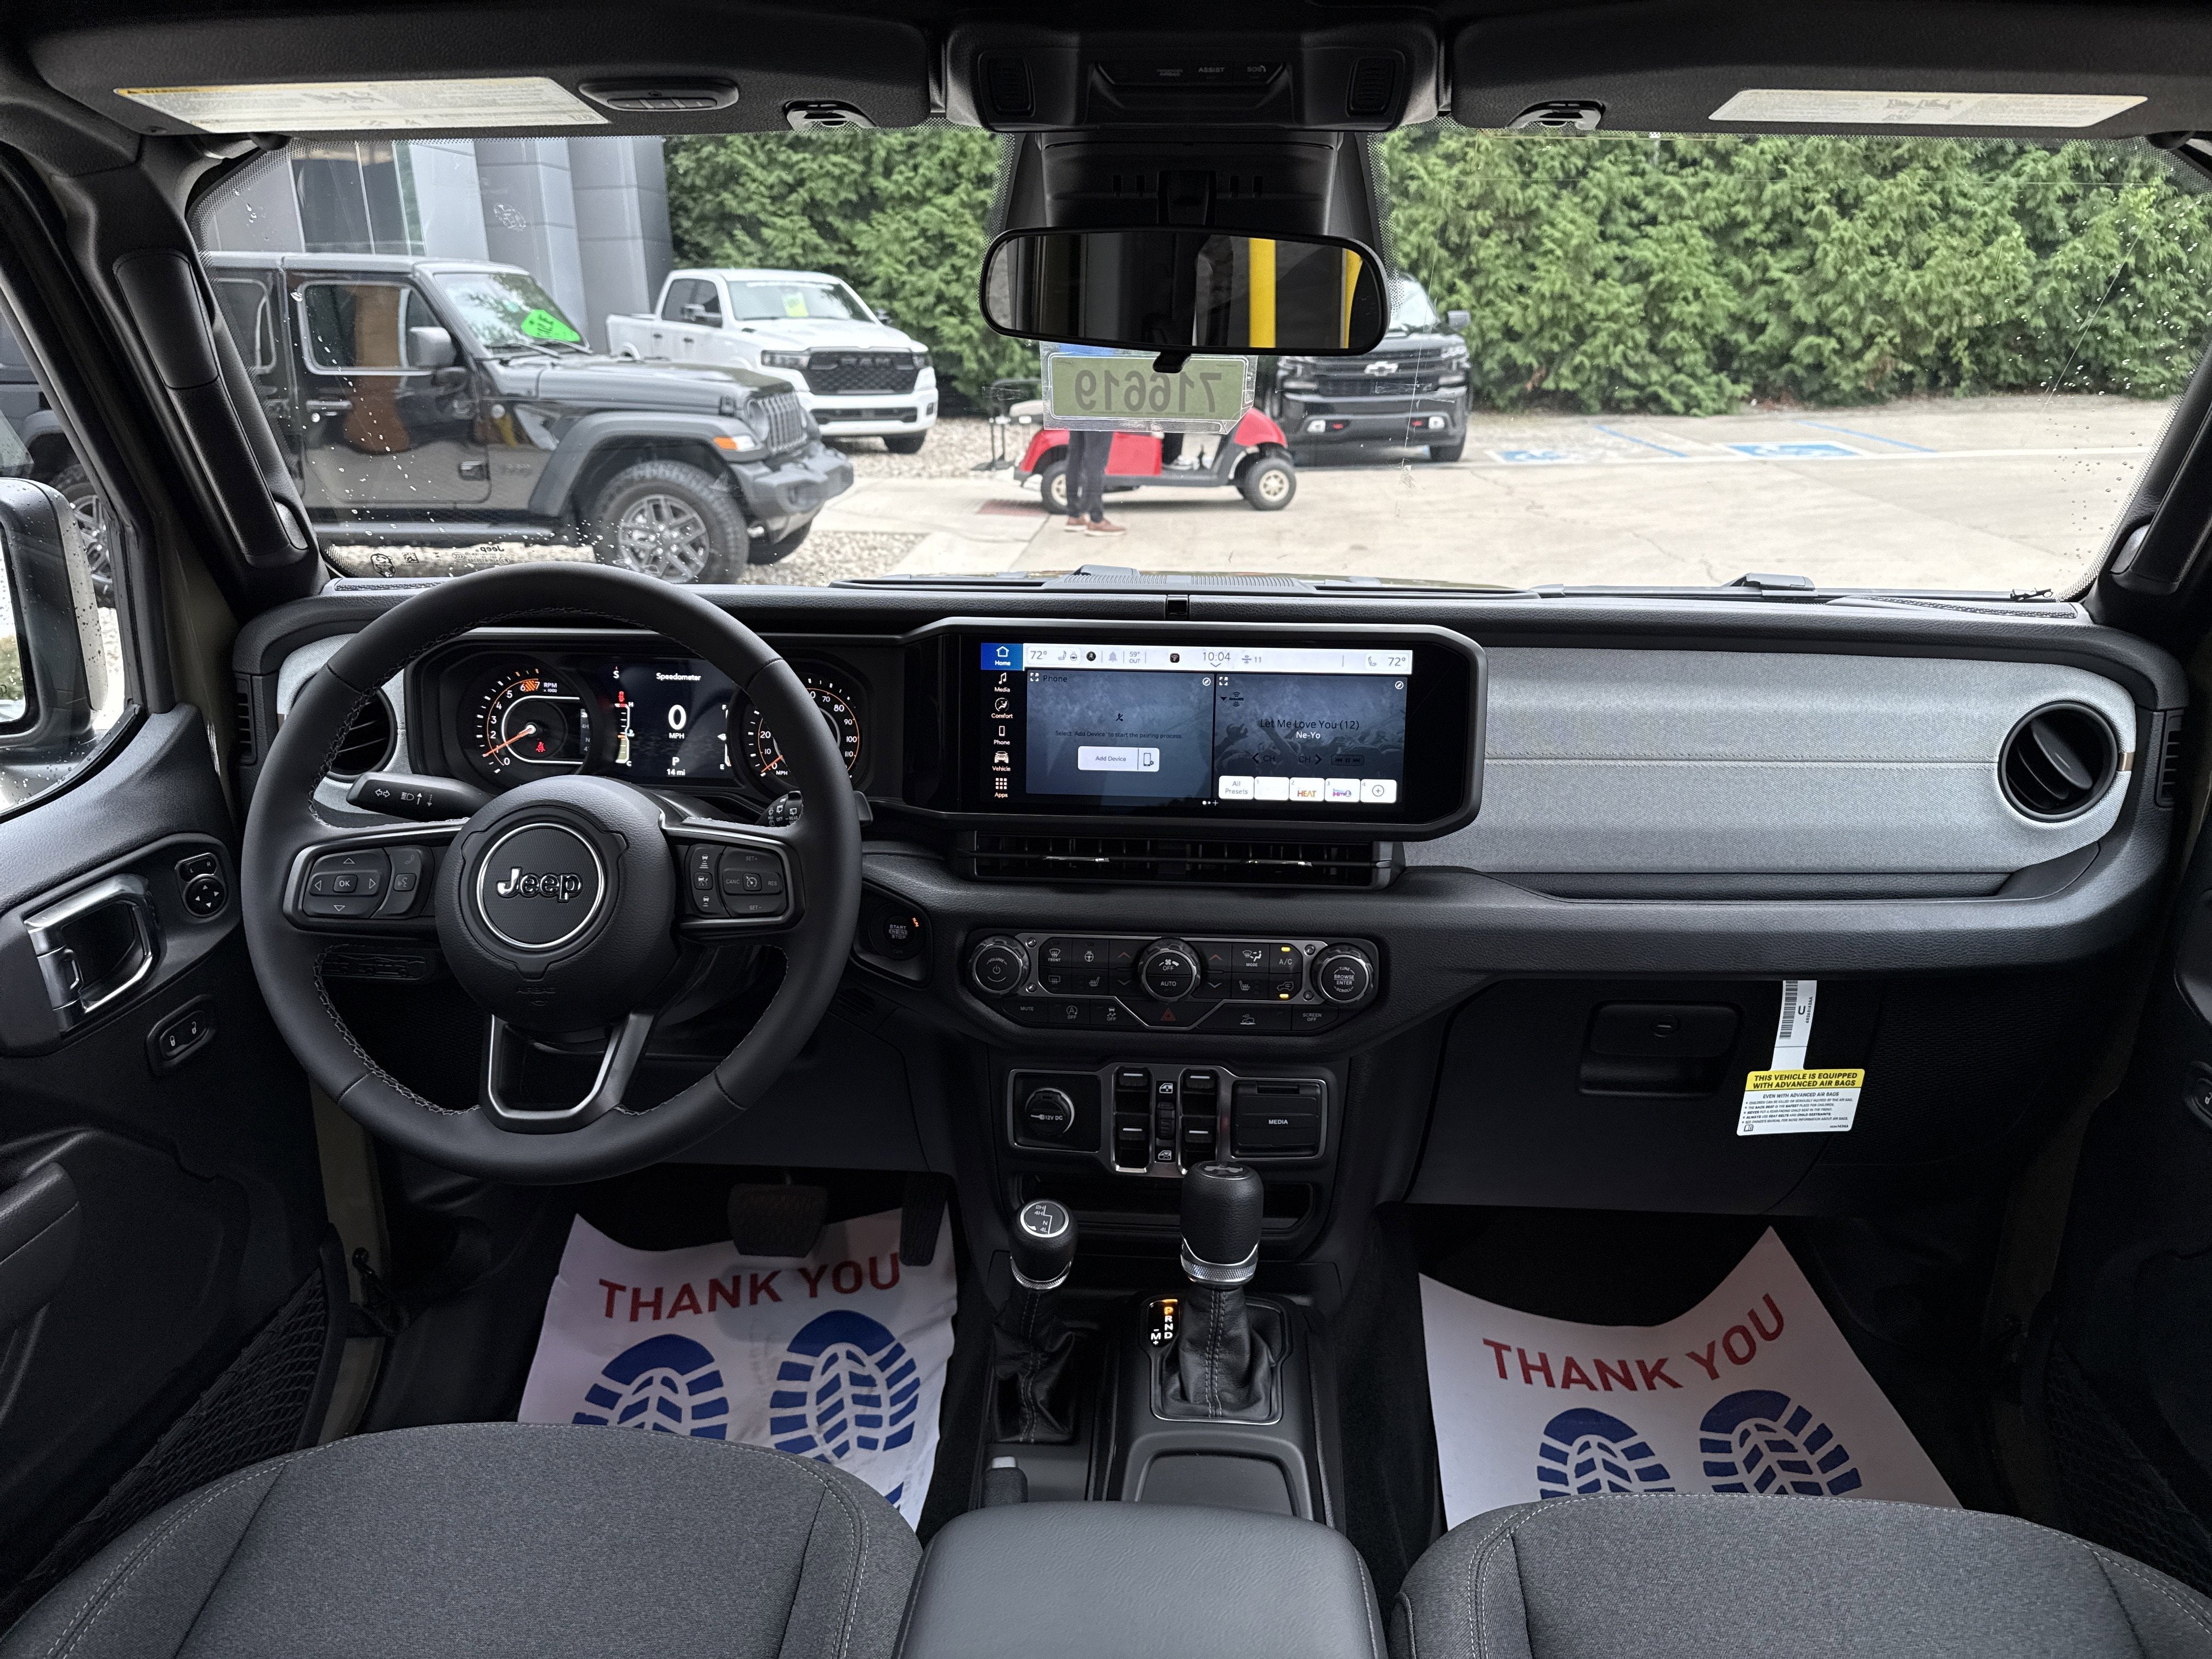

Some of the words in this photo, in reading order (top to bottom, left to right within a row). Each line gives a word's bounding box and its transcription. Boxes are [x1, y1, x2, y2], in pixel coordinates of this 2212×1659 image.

[1030, 650, 1047, 660] 72°
[1203, 652, 1231, 662] 10:04
[1388, 657, 1406, 667] 72°
[613, 670, 619, 679] S
[656, 672, 701, 681] Speedometer
[535, 681, 540, 690] 7
[506, 690, 513, 698] 5
[668, 704, 686, 730] 0
[1260, 719, 1274, 728] Let
[1277, 719, 1291, 728] Me
[1294, 720, 1316, 729] Love
[1318, 720, 1337, 729] You
[1340, 720, 1359, 731] (12)
[490, 731, 496, 739] 2
[1296, 731, 1321, 739] Ne-Yo
[504, 757, 510, 765] 0
[672, 757, 680, 766] P
[497, 867, 583, 903] Jeep
[1798, 1006, 1805, 1015] U
[599, 1269, 782, 1322] THANK
[798, 1252, 901, 1299] YOU
[1164, 1306, 1173, 1315] P
[1150, 1332, 1161, 1340] M
[1482, 1338, 1683, 1392] THANK
[1686, 1293, 1785, 1381] YOU
